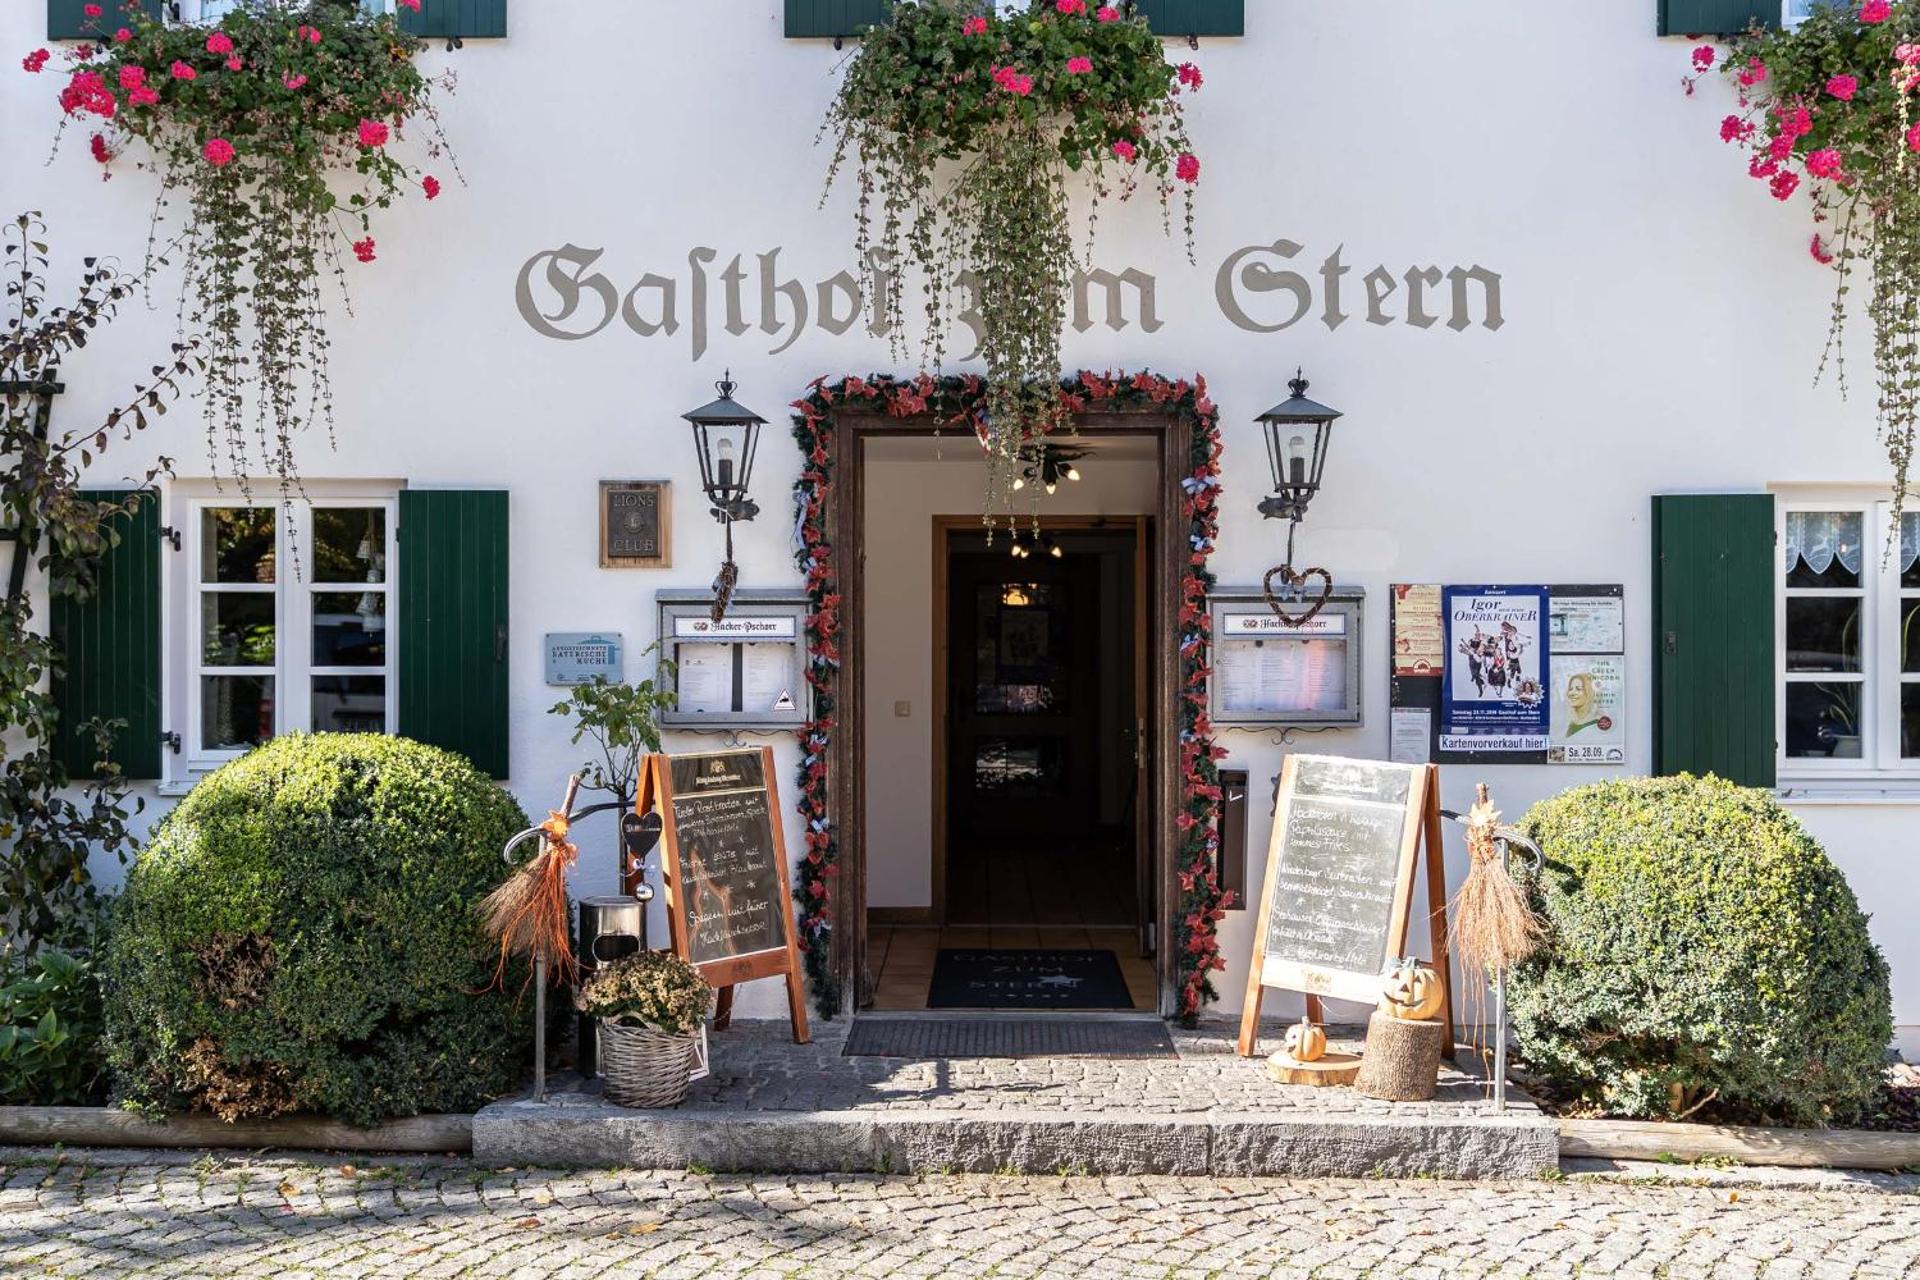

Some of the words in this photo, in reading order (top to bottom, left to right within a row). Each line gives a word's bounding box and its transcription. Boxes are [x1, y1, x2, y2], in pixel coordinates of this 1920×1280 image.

[952, 266, 1165, 361] zm
[1215, 238, 1506, 333] Stern
[614, 494, 654, 507] LIONS
[614, 539, 654, 551] CLUB
[1471, 598, 1502, 612] Igor
[1442, 736, 1523, 749] Kartenvorverkauf
[1525, 736, 1548, 749] hier!
[1568, 746, 1581, 757] Sa.
[1582, 746, 1605, 758] 28.09.
[953, 953, 1095, 963] GASTHOF
[992, 965, 1063, 973] ZUM
[968, 980, 1079, 990] STERN
